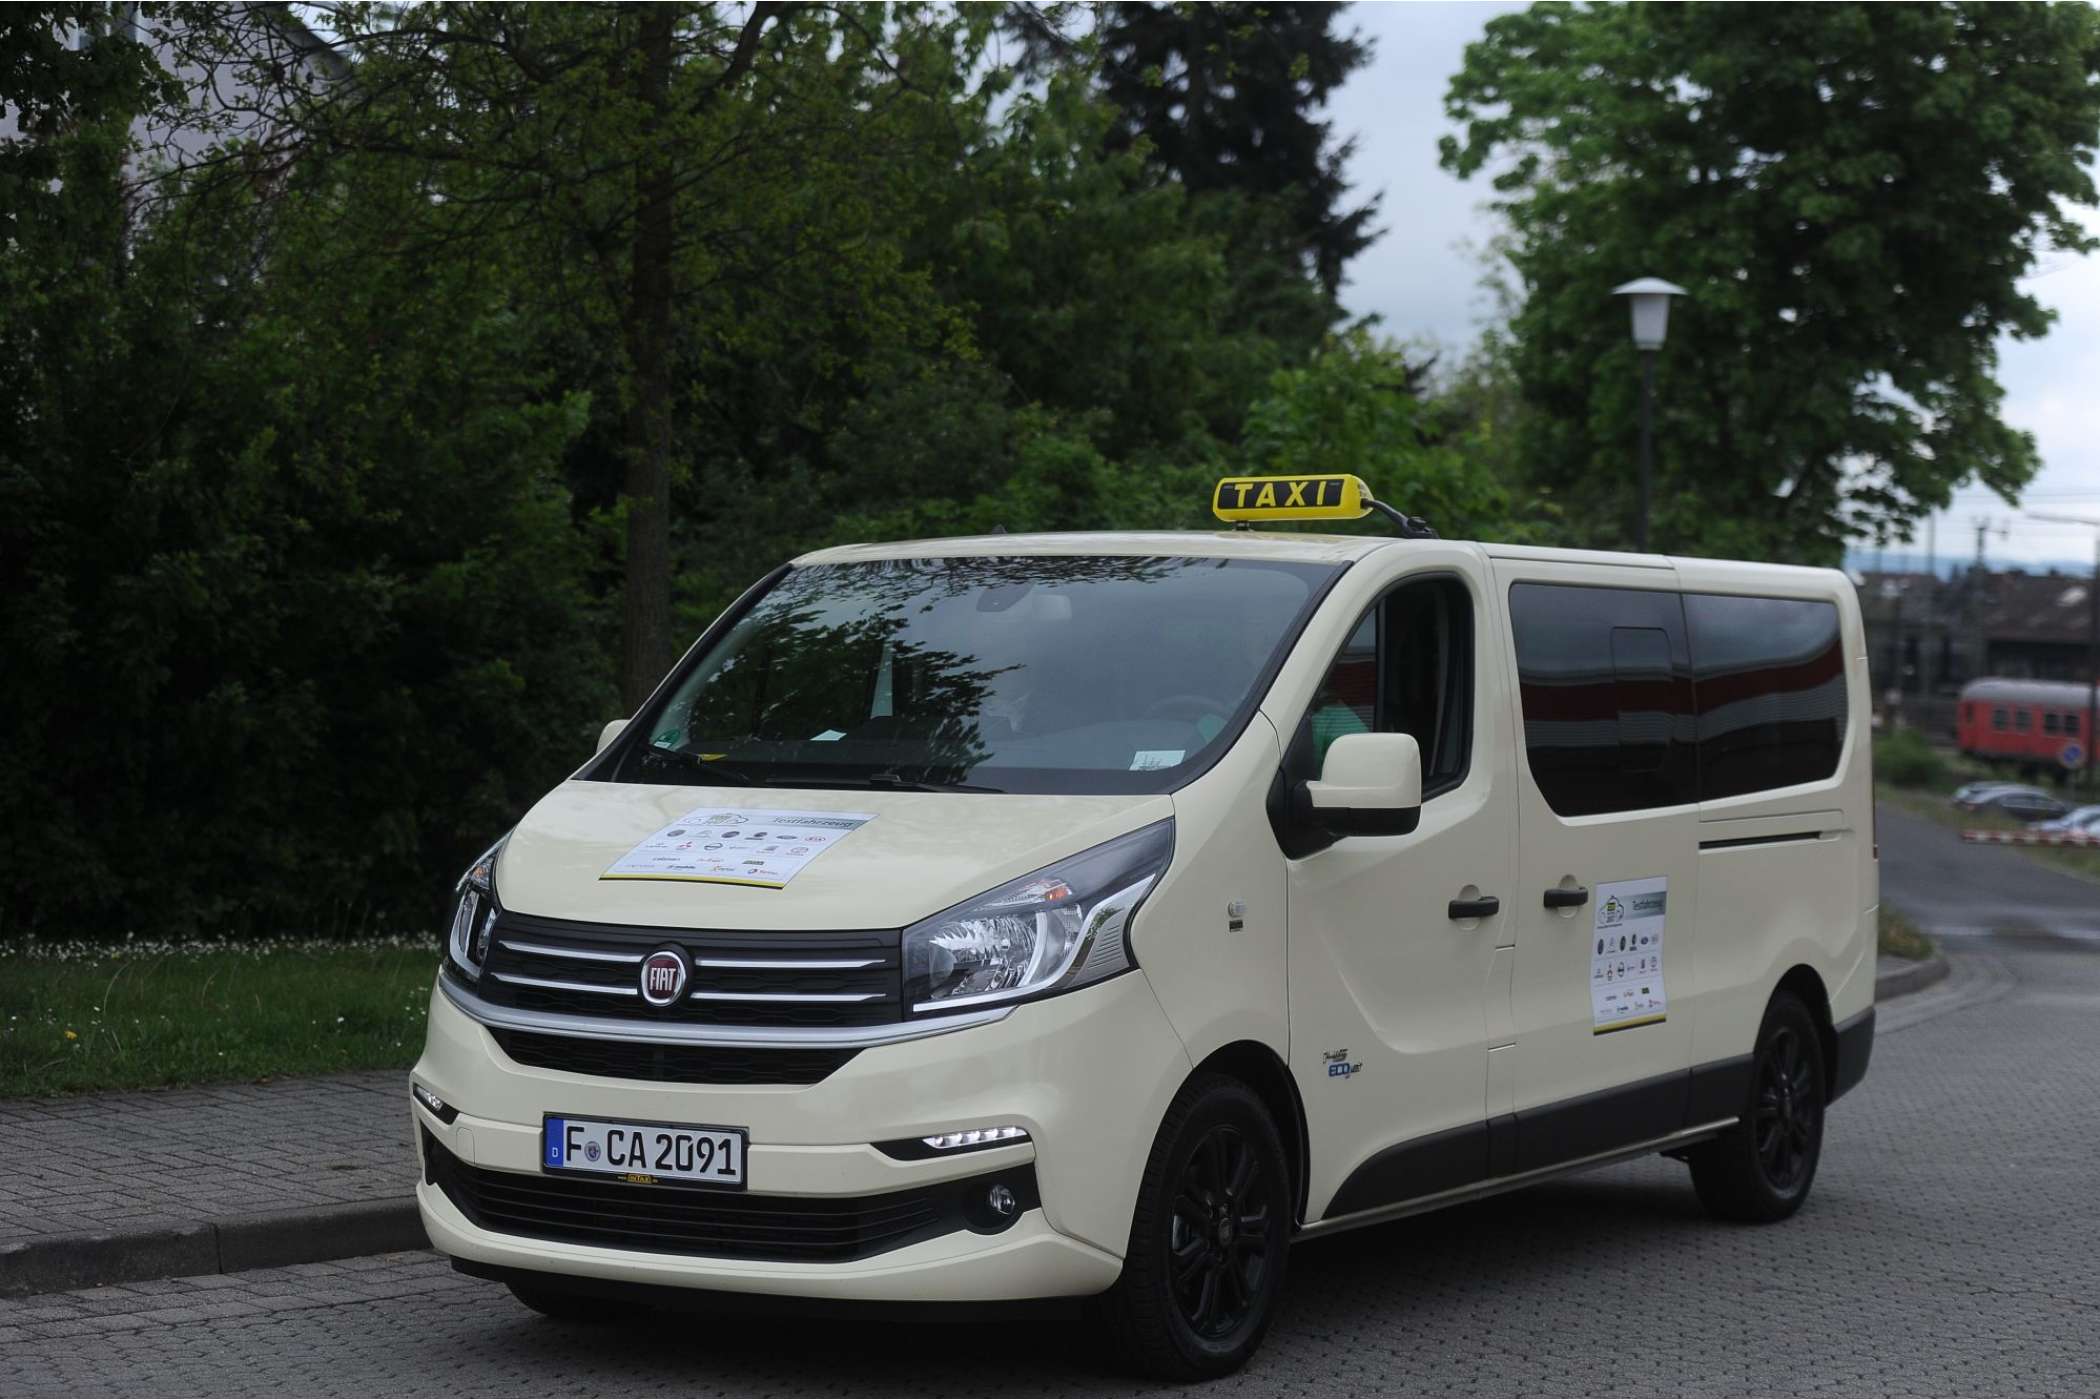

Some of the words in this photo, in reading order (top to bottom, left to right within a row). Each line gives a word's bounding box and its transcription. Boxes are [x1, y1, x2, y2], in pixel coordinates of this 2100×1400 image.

[1234, 481, 1327, 507] TAXI
[649, 967, 677, 991] FIAT
[566, 1126, 585, 1162] F
[607, 1129, 647, 1169] CA
[655, 1133, 737, 1176] 2091
